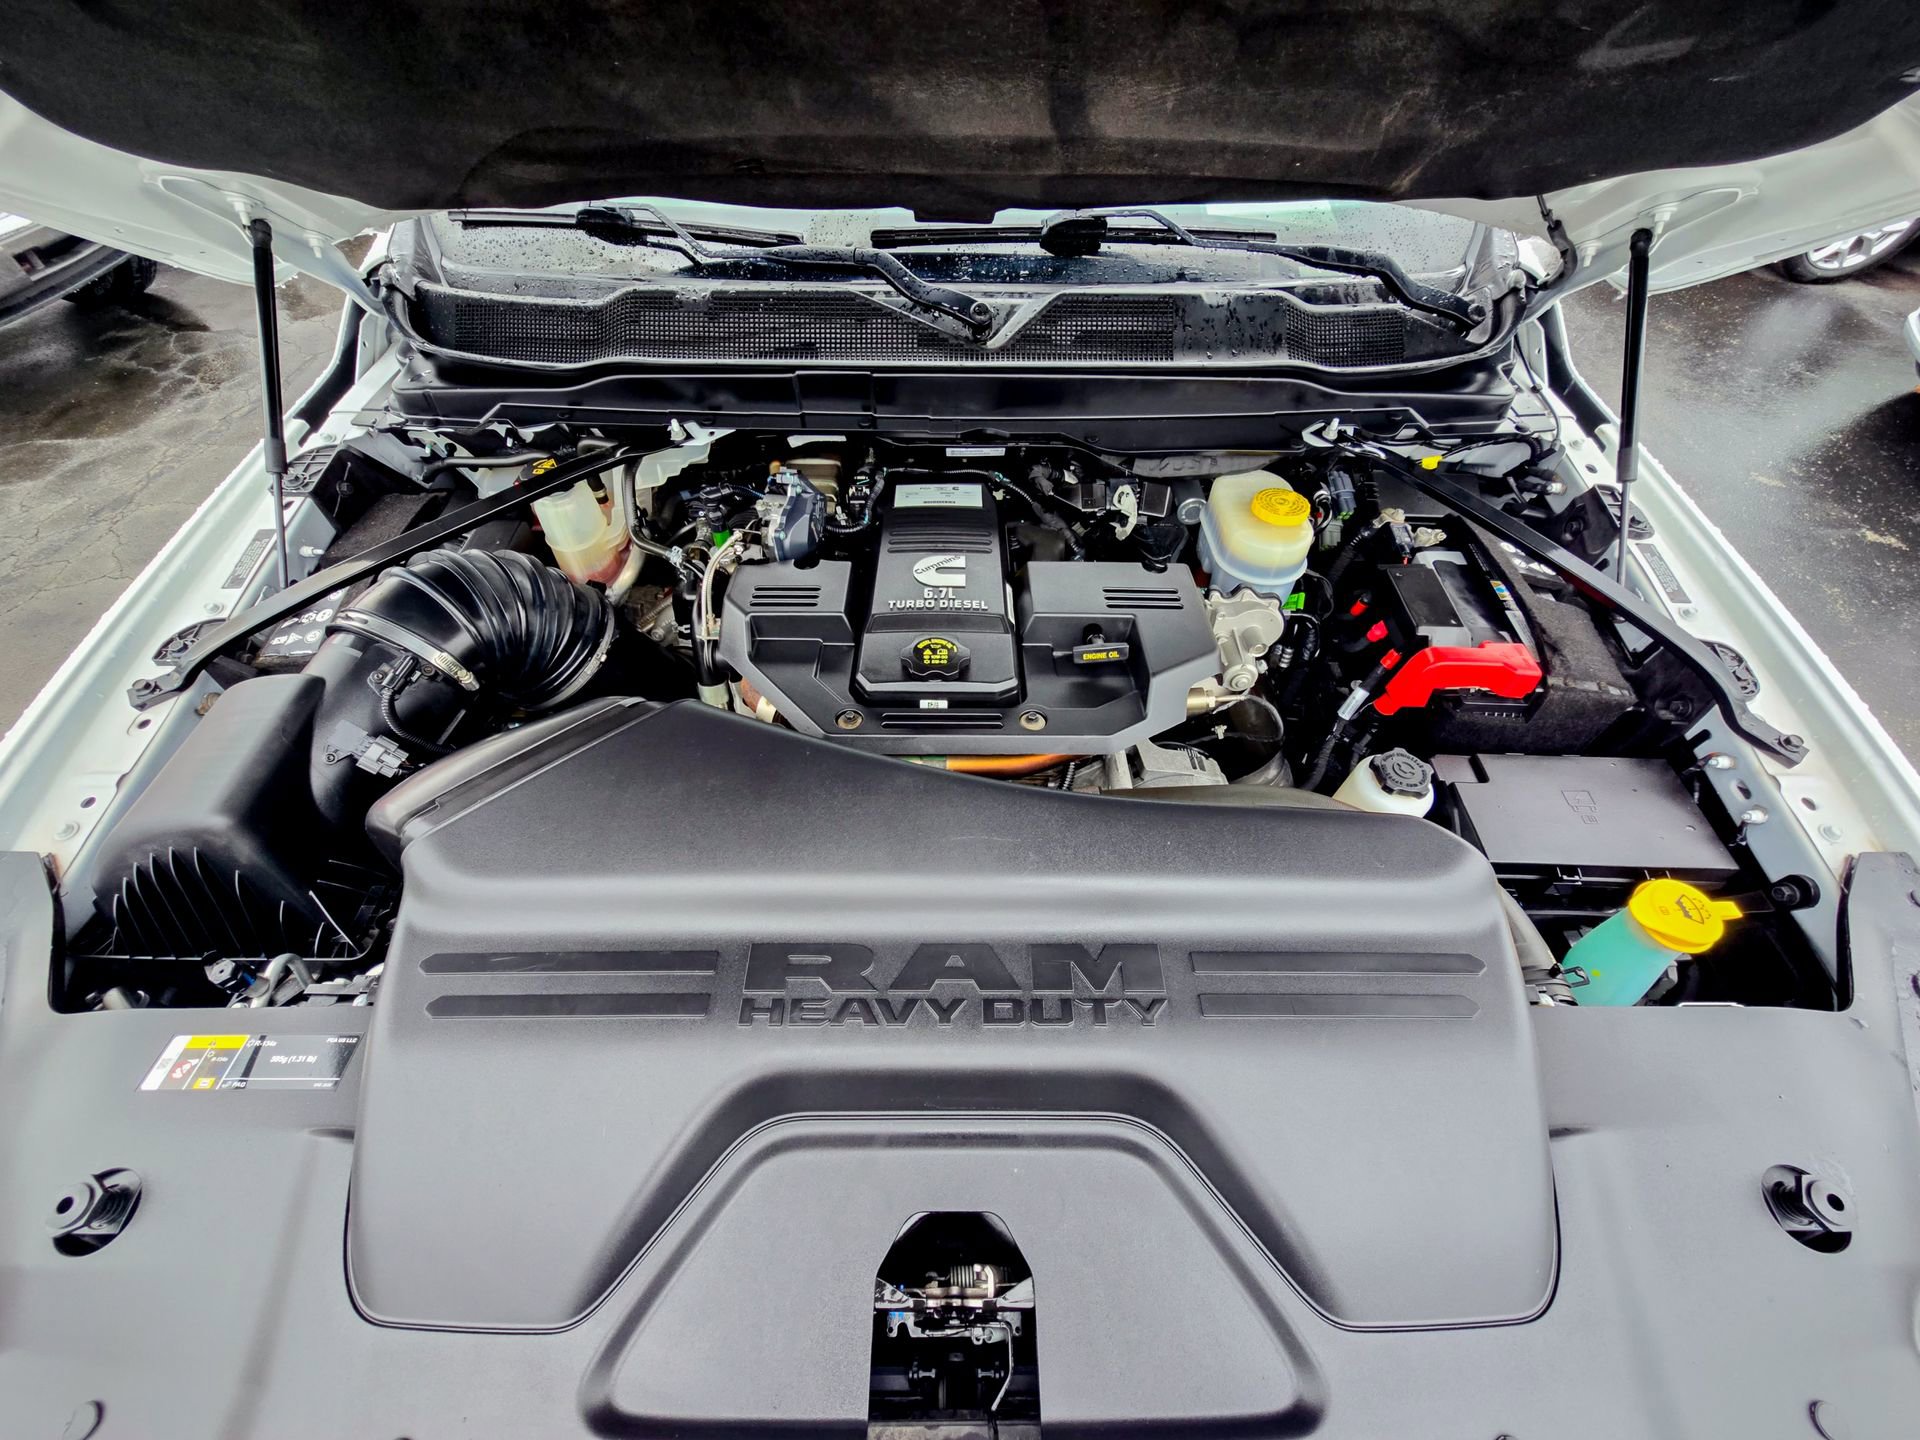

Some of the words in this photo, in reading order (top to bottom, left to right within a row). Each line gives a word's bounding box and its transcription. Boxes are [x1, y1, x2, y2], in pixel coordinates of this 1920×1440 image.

[914, 554, 961, 575] Cummins
[923, 587, 956, 599] 6.7L
[888, 599, 935, 610] TURBO
[939, 599, 989, 610] DIESEL
[1082, 652, 1108, 660] ENGINE
[1108, 650, 1120, 658] OIL
[743, 943, 1167, 994] RAM
[737, 998, 968, 1027] HEAVY
[982, 998, 1169, 1027] DUTY
